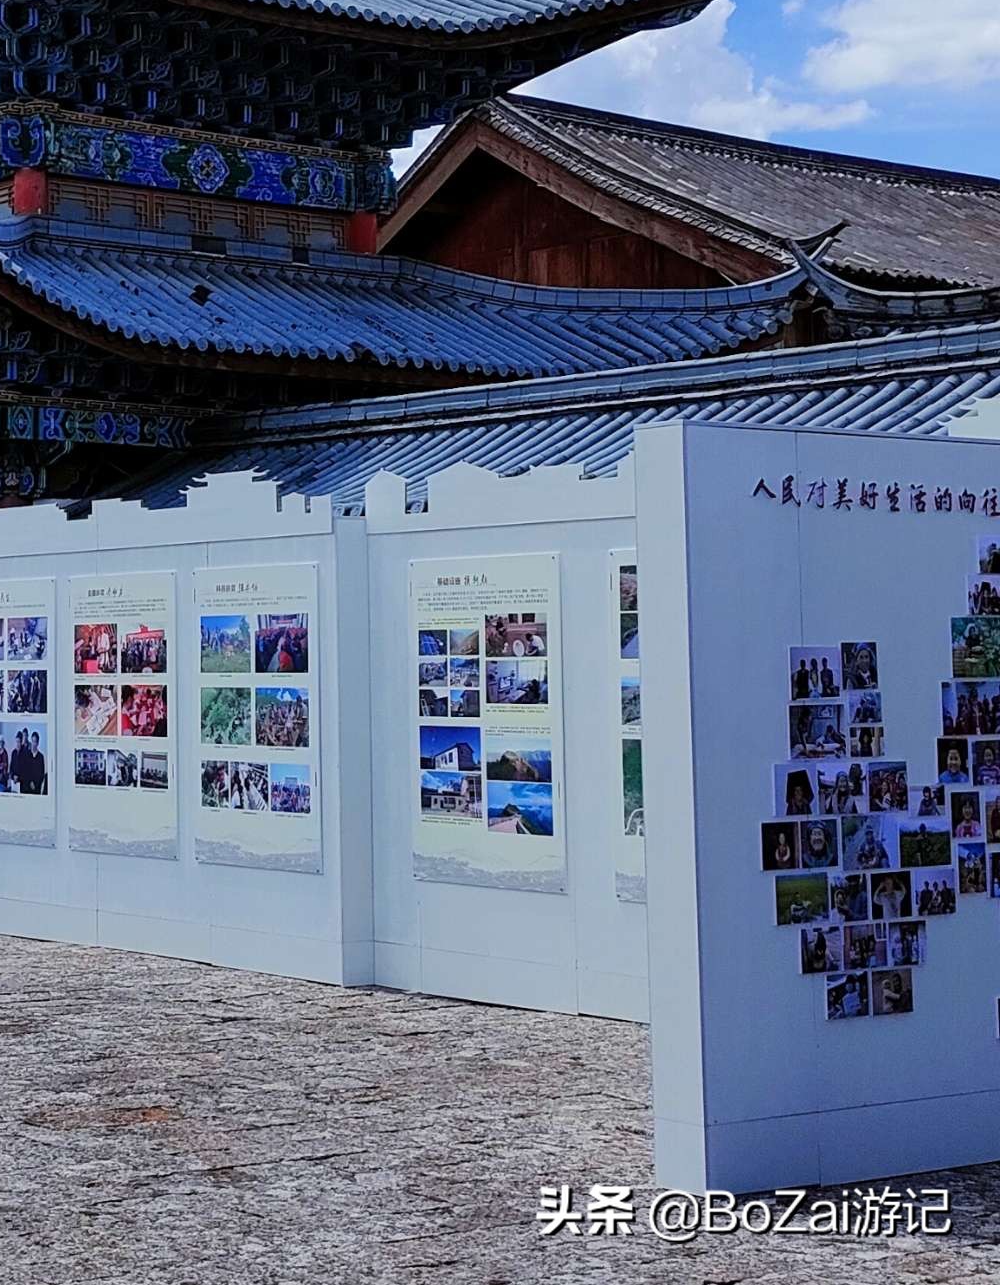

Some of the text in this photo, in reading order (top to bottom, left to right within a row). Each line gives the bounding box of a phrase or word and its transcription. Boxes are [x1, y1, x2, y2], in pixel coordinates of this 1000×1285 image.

[752, 474, 1000, 517] 人民对美好生活的向往
